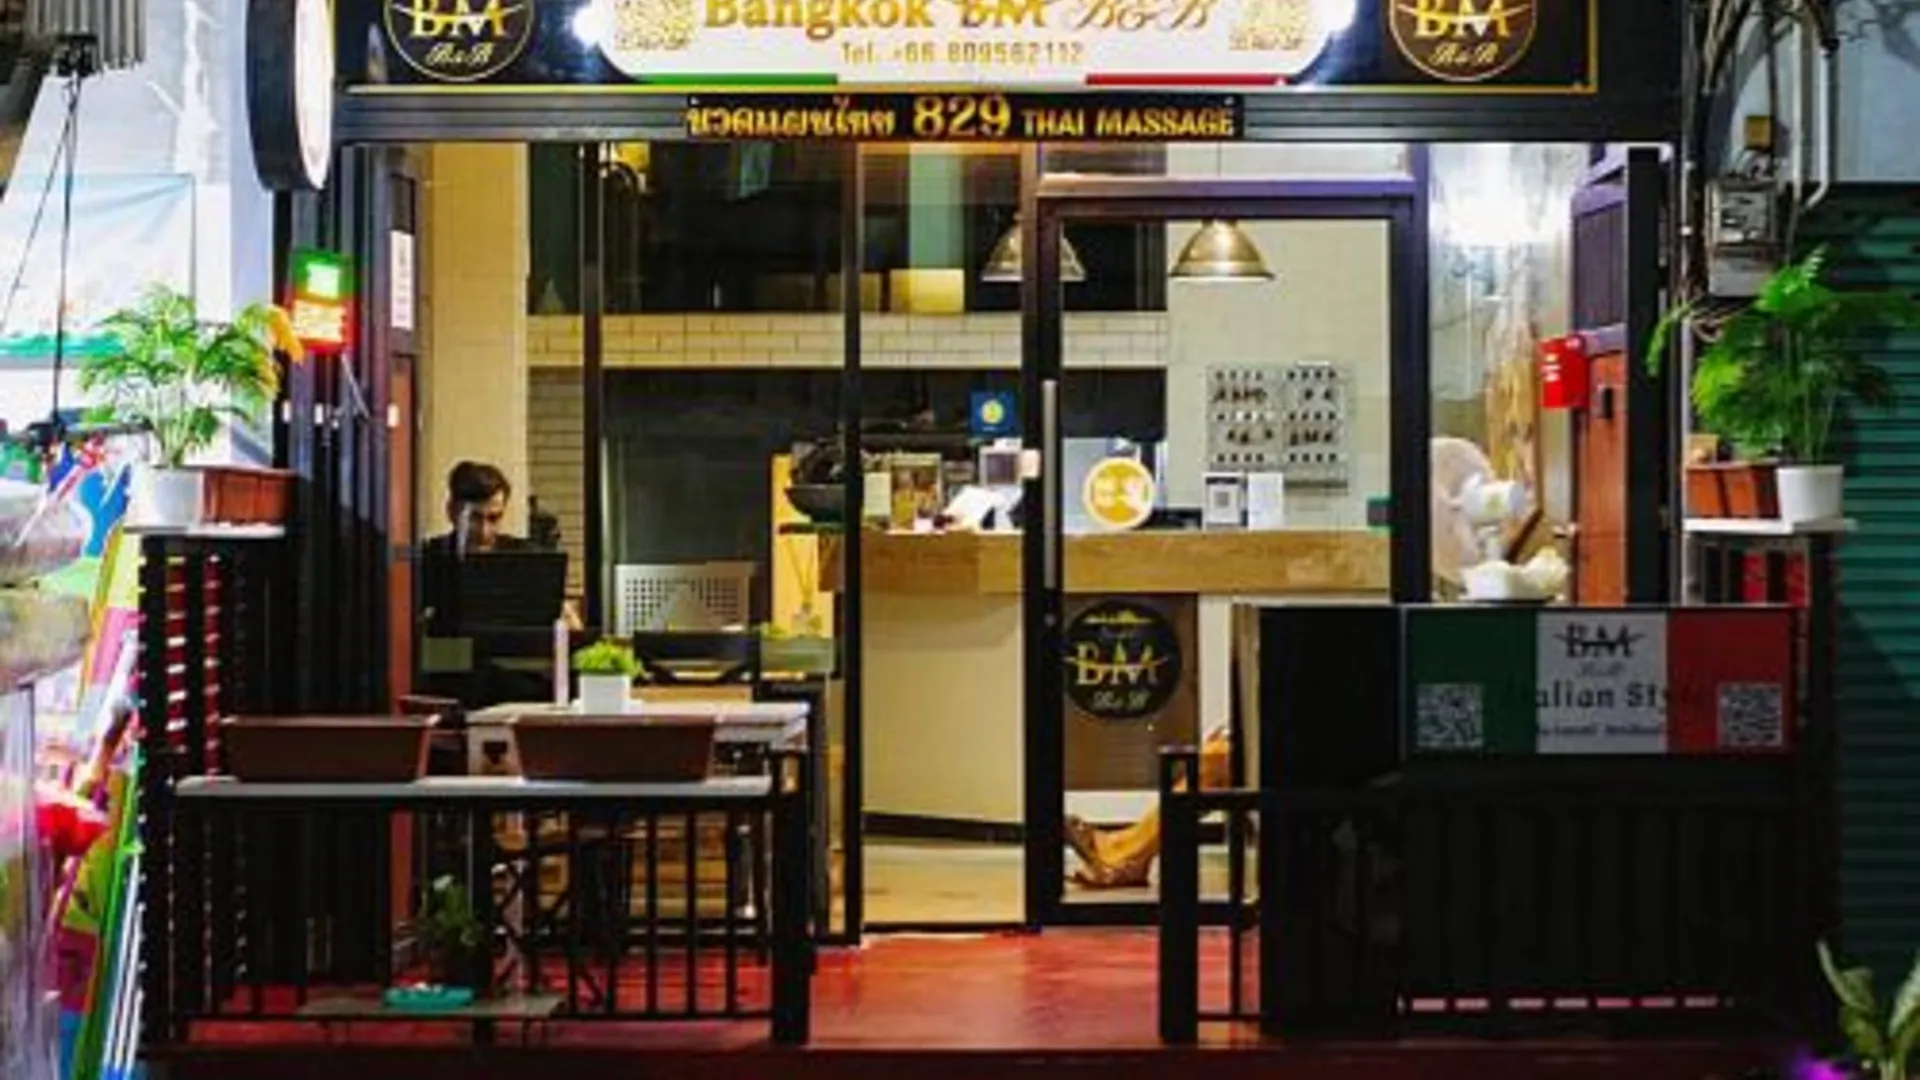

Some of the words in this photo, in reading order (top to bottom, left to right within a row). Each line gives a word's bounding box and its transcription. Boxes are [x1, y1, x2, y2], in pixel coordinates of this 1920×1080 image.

[409, 0, 513, 37] BM
[704, 0, 934, 41] Bangkok
[1413, 0, 1510, 37] BM
[912, 95, 1012, 137] 829
[1021, 107, 1085, 137] THAI
[1094, 106, 1236, 137] MASSAGE
[1077, 641, 1159, 685] BM
